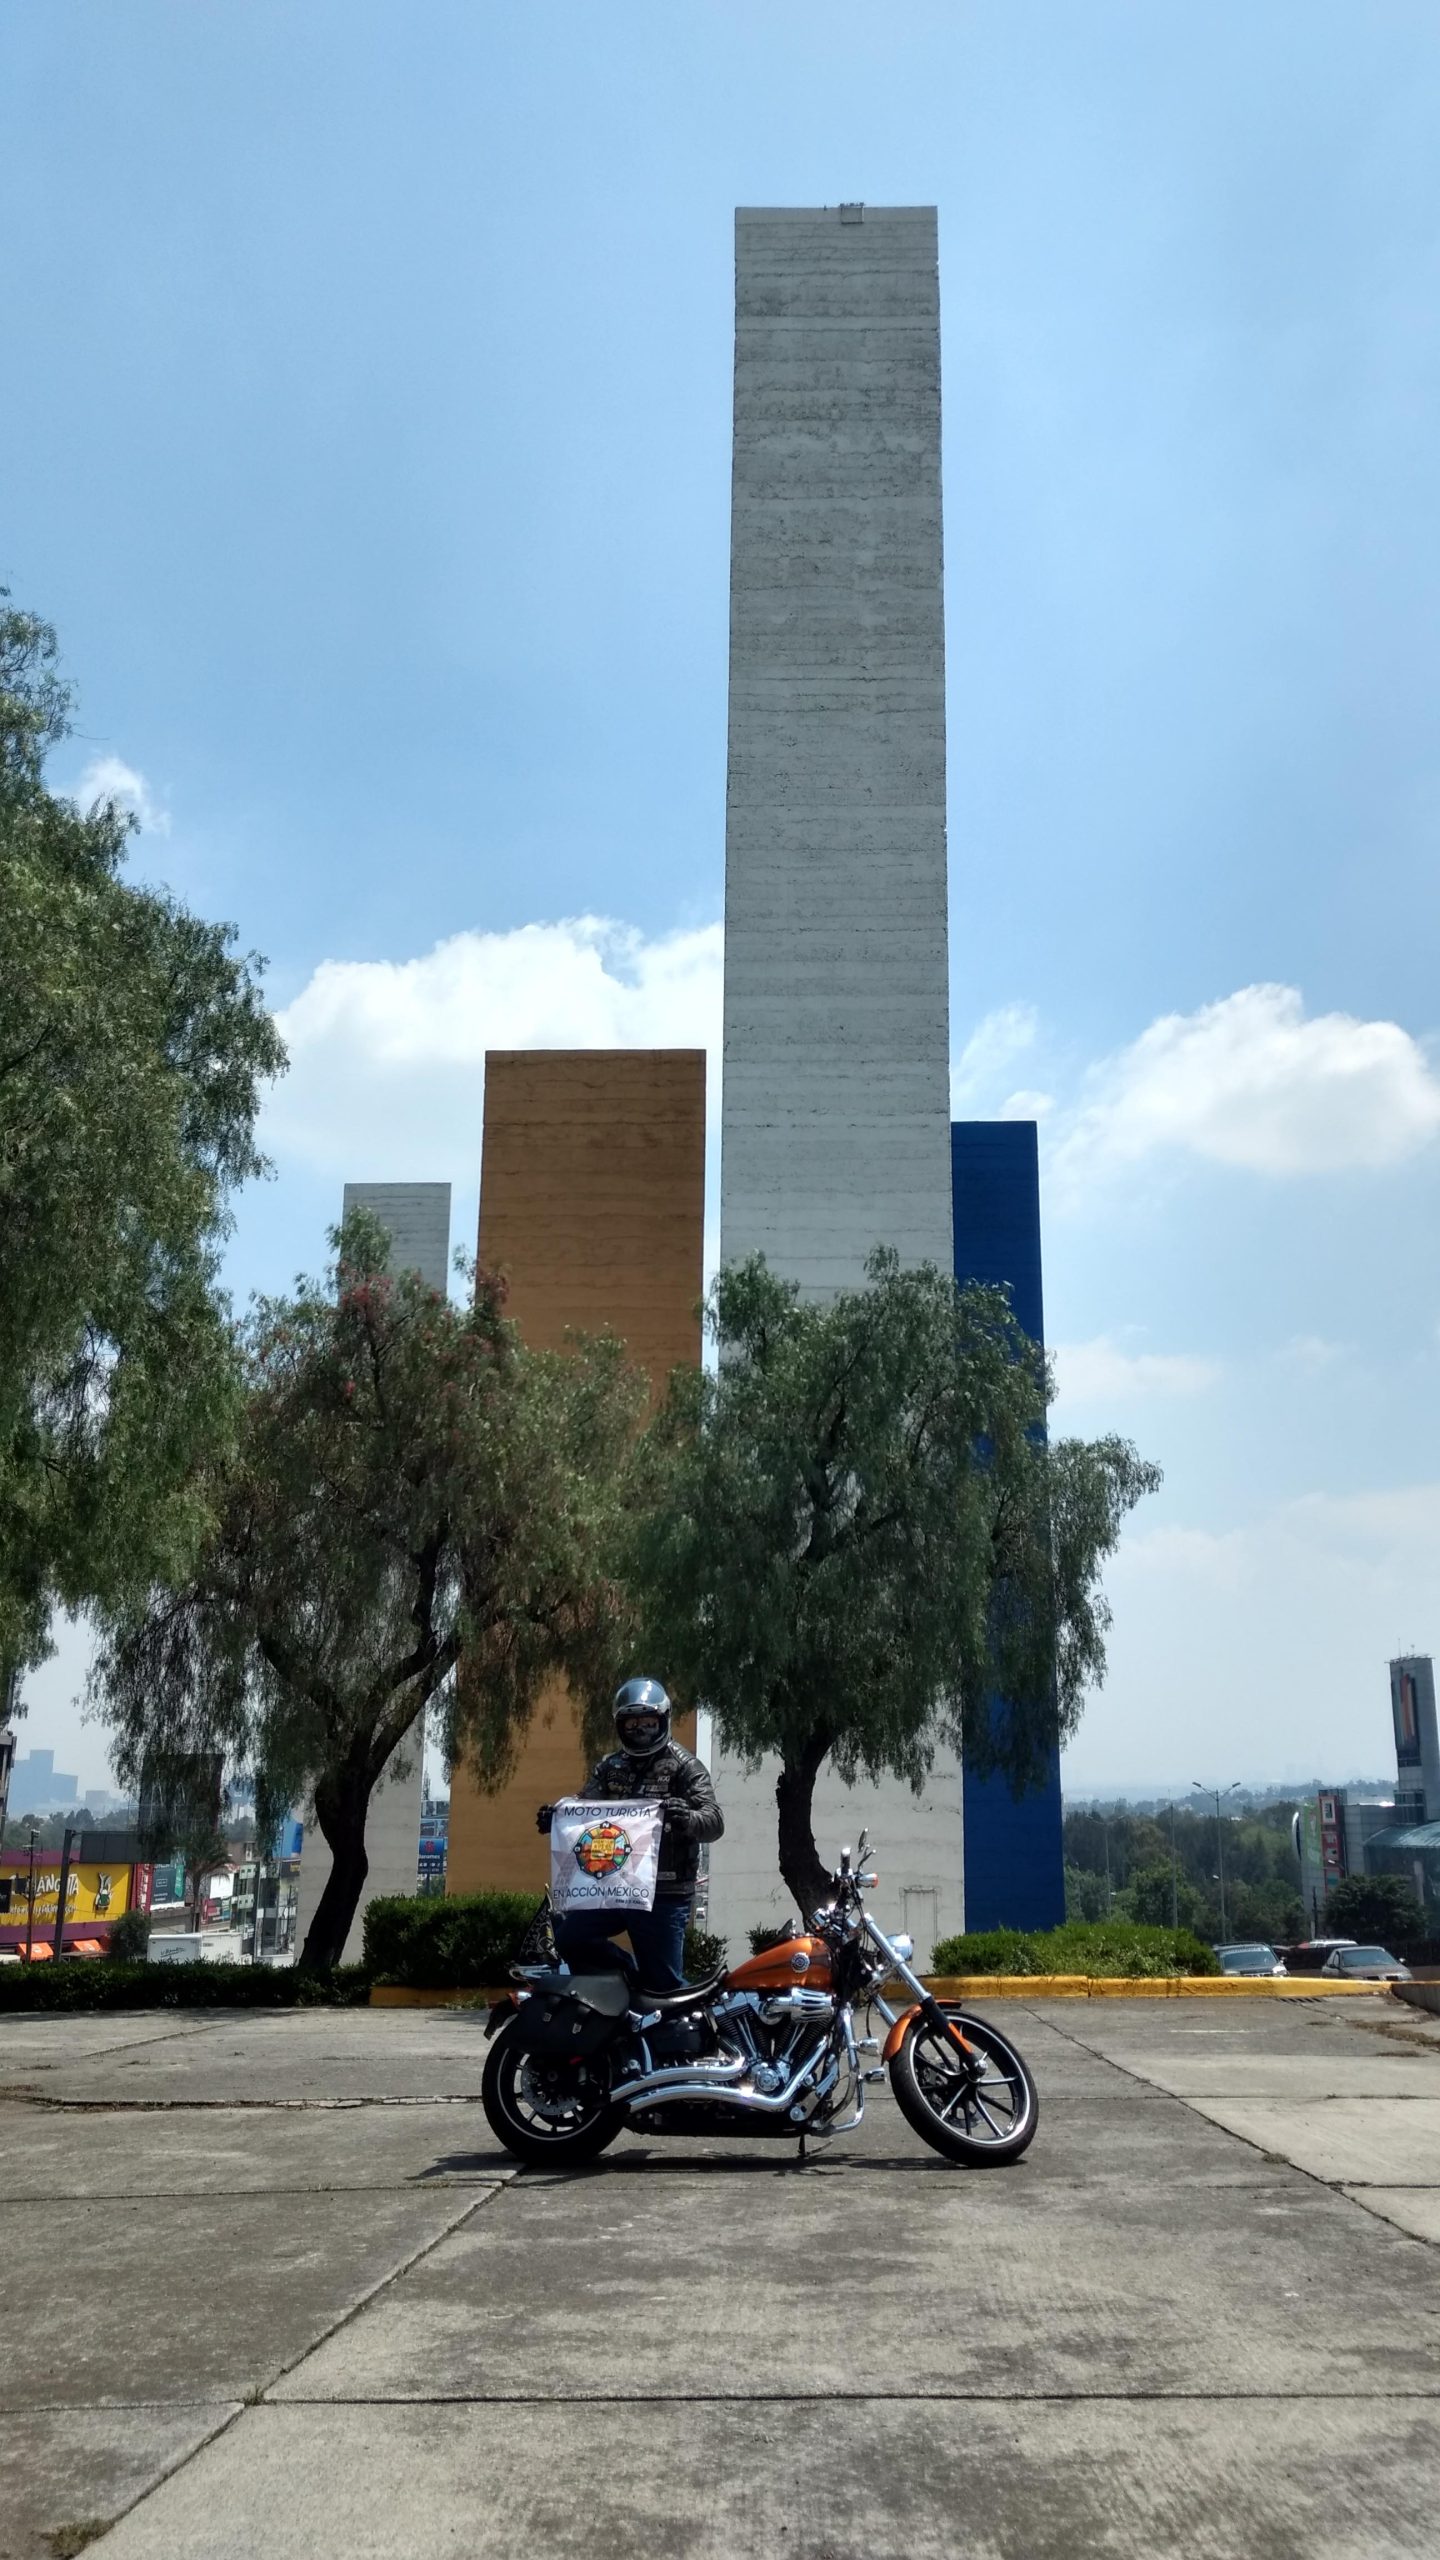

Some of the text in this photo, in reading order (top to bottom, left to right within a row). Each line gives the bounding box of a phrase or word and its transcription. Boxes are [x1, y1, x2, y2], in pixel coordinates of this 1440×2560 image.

[564, 1806, 602, 1816] MOTO
[553, 1884, 650, 1899] EN ACCIÓN MÉXICO
